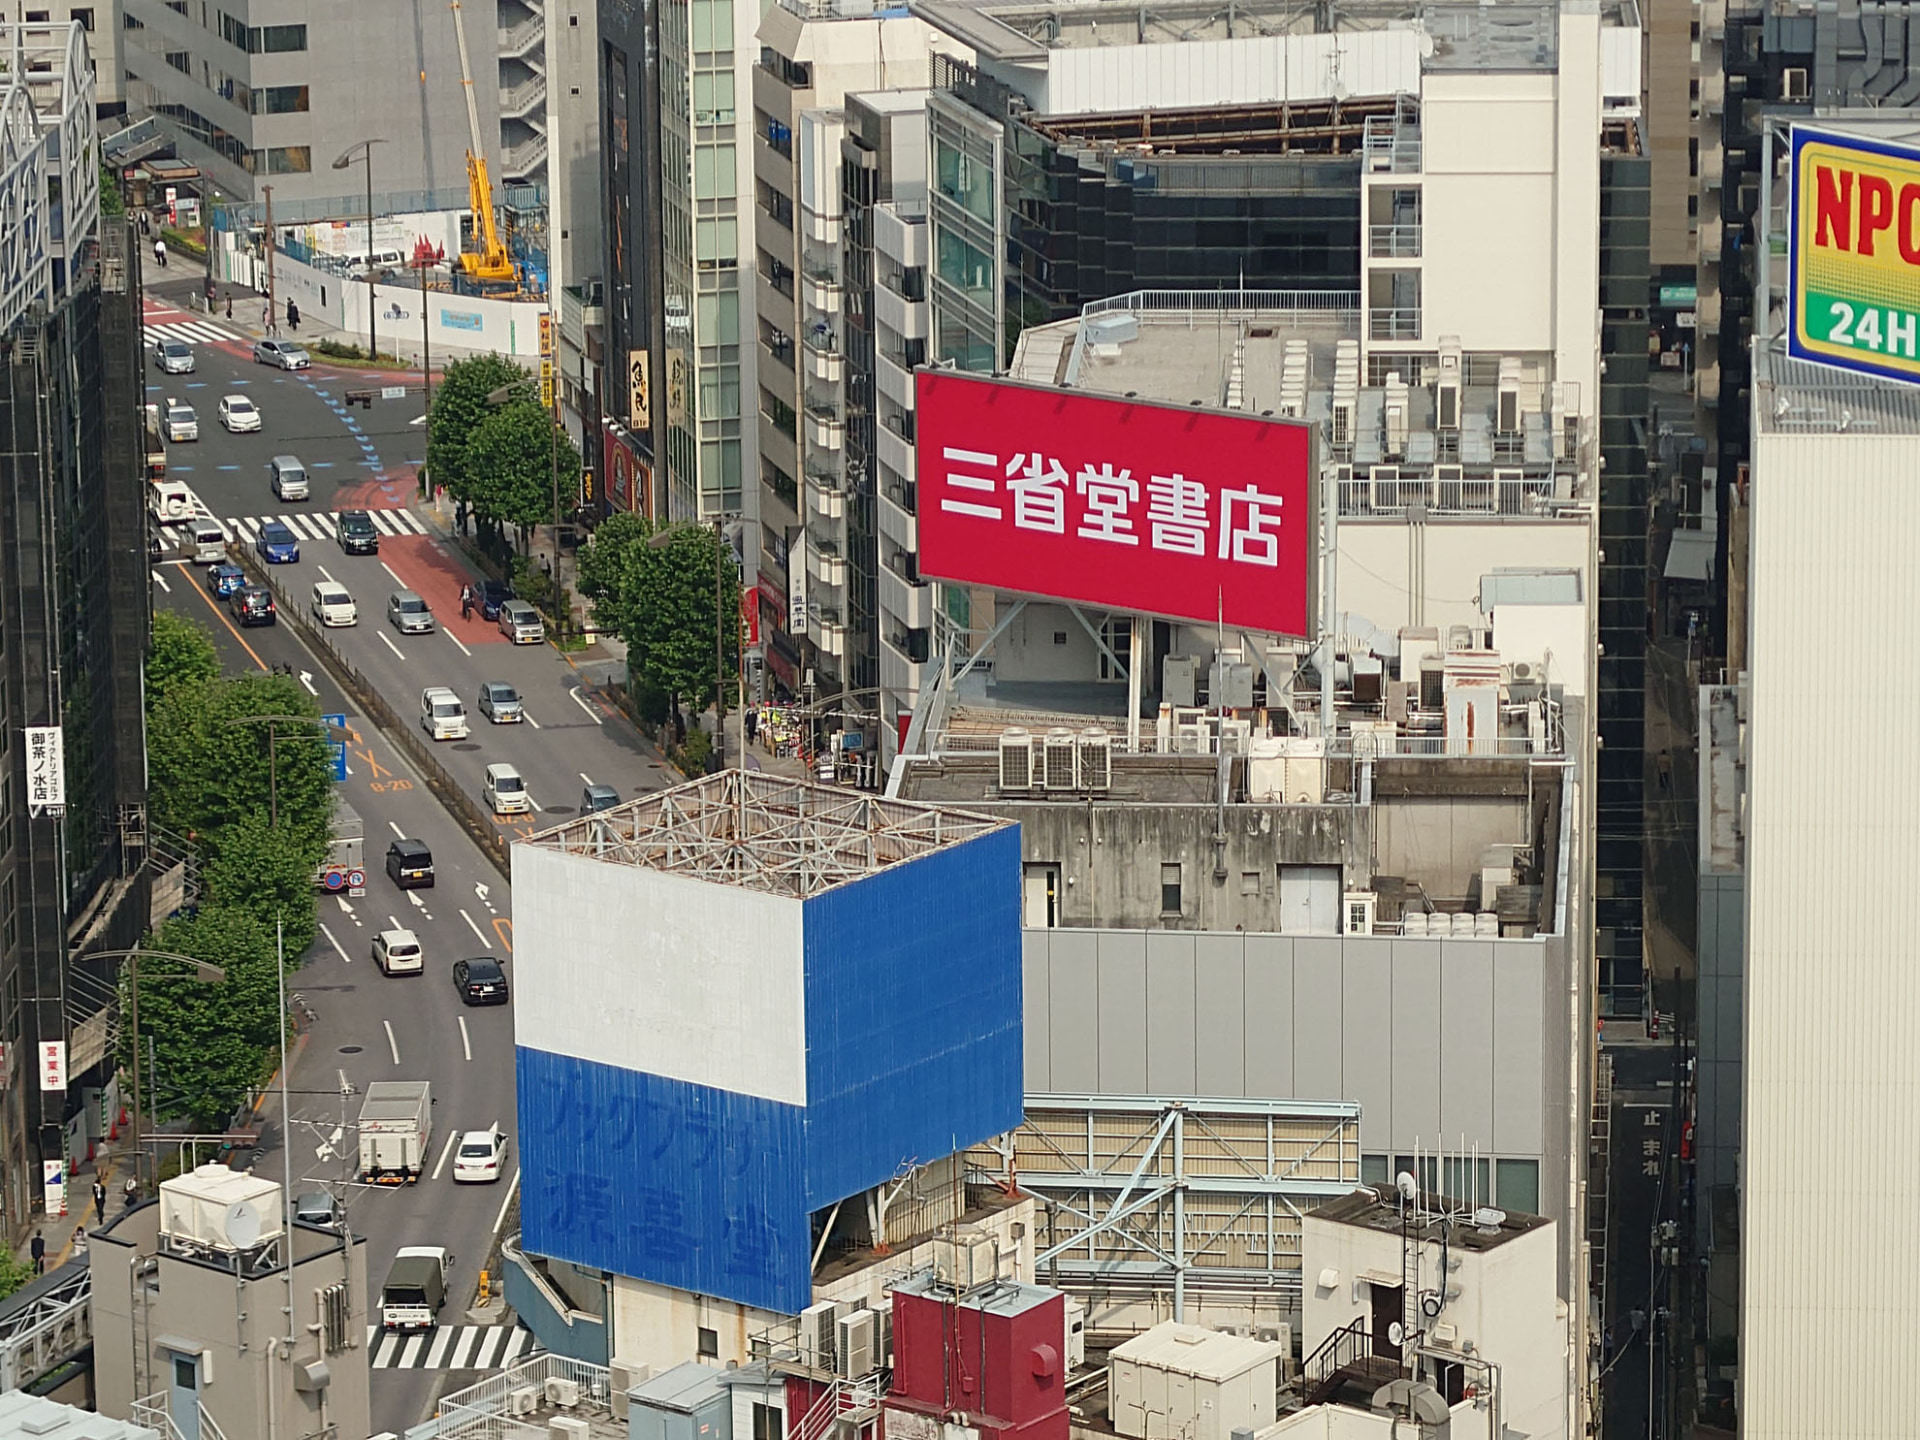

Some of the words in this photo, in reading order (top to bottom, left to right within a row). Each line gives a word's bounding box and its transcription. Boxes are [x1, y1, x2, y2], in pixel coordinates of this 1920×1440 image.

[1829, 302, 1916, 357] 24H
[941, 447, 1283, 566] 三省堂書店
[31, 732, 47, 800] 御茶ノ水店
[48, 732, 58, 800] ヴィクトリアゴルフ
[46, 1046, 58, 1086] 営業中
[1642, 1110, 1661, 1176] 止まれ
